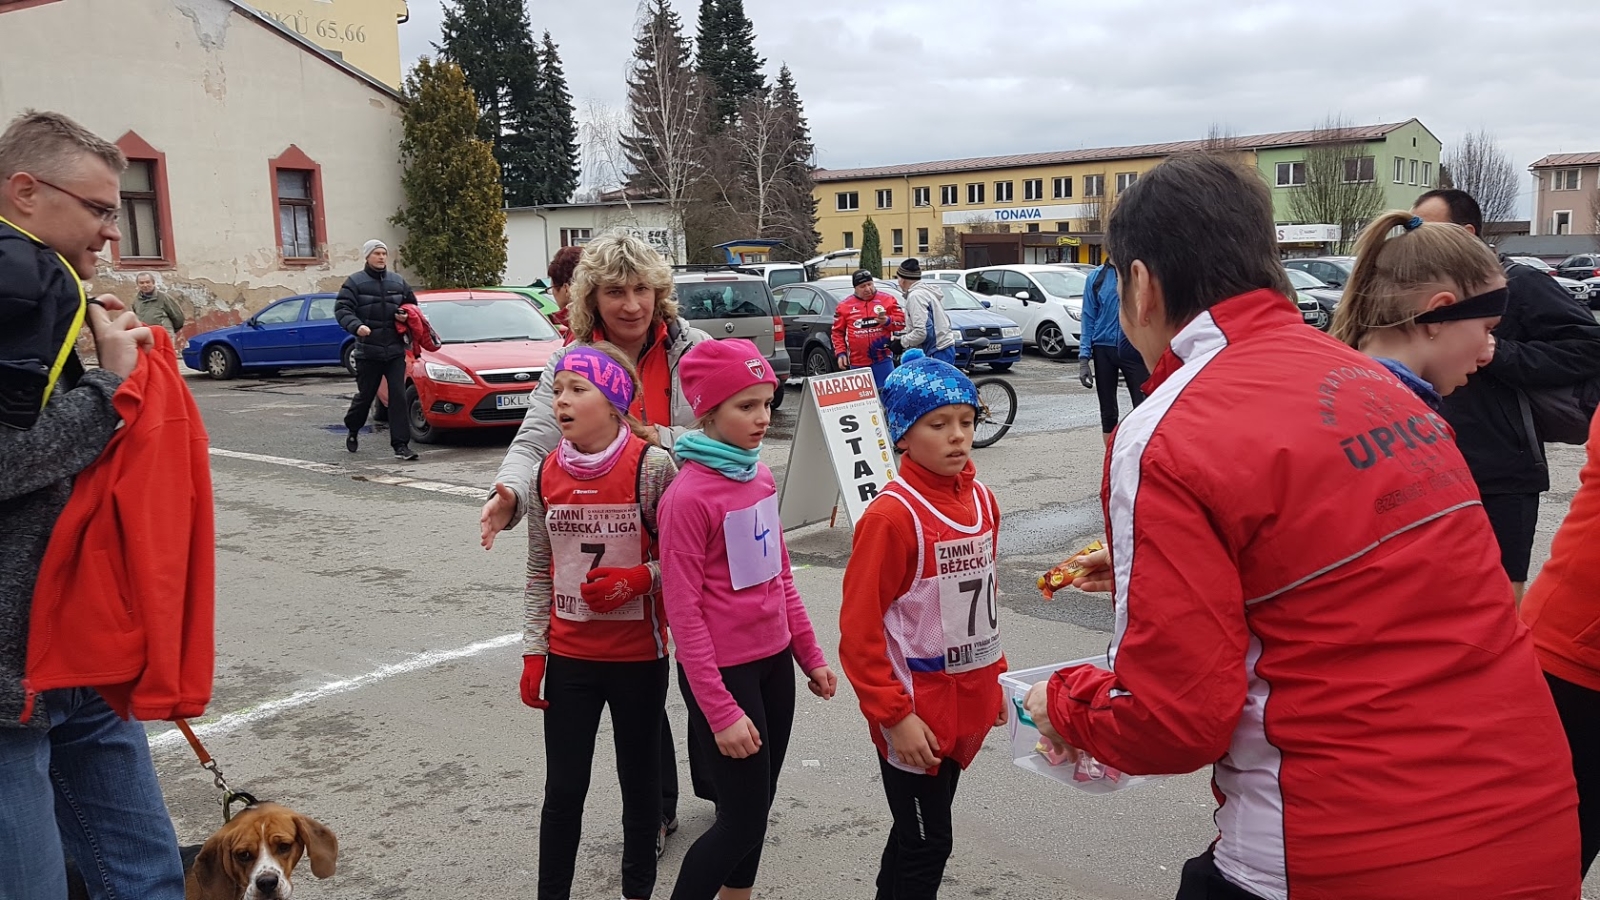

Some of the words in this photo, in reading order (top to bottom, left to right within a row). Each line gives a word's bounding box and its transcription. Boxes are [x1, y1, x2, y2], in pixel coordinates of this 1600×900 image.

[315, 19, 366, 43] 65,66
[995, 208, 1042, 220] TONAVA
[812, 373, 873, 397] MARATON
[858, 389, 873, 398] stav
[503, 396, 524, 406] DKL
[838, 414, 879, 502] STAR
[549, 508, 584, 520] ZIMNÍ
[549, 520, 602, 533] BĚŽECKÁ
[607, 522, 637, 533] LIGA
[754, 508, 770, 557] 4
[939, 541, 975, 559] ZIMNÍ
[580, 543, 606, 584] 7
[958, 572, 997, 637] 70
